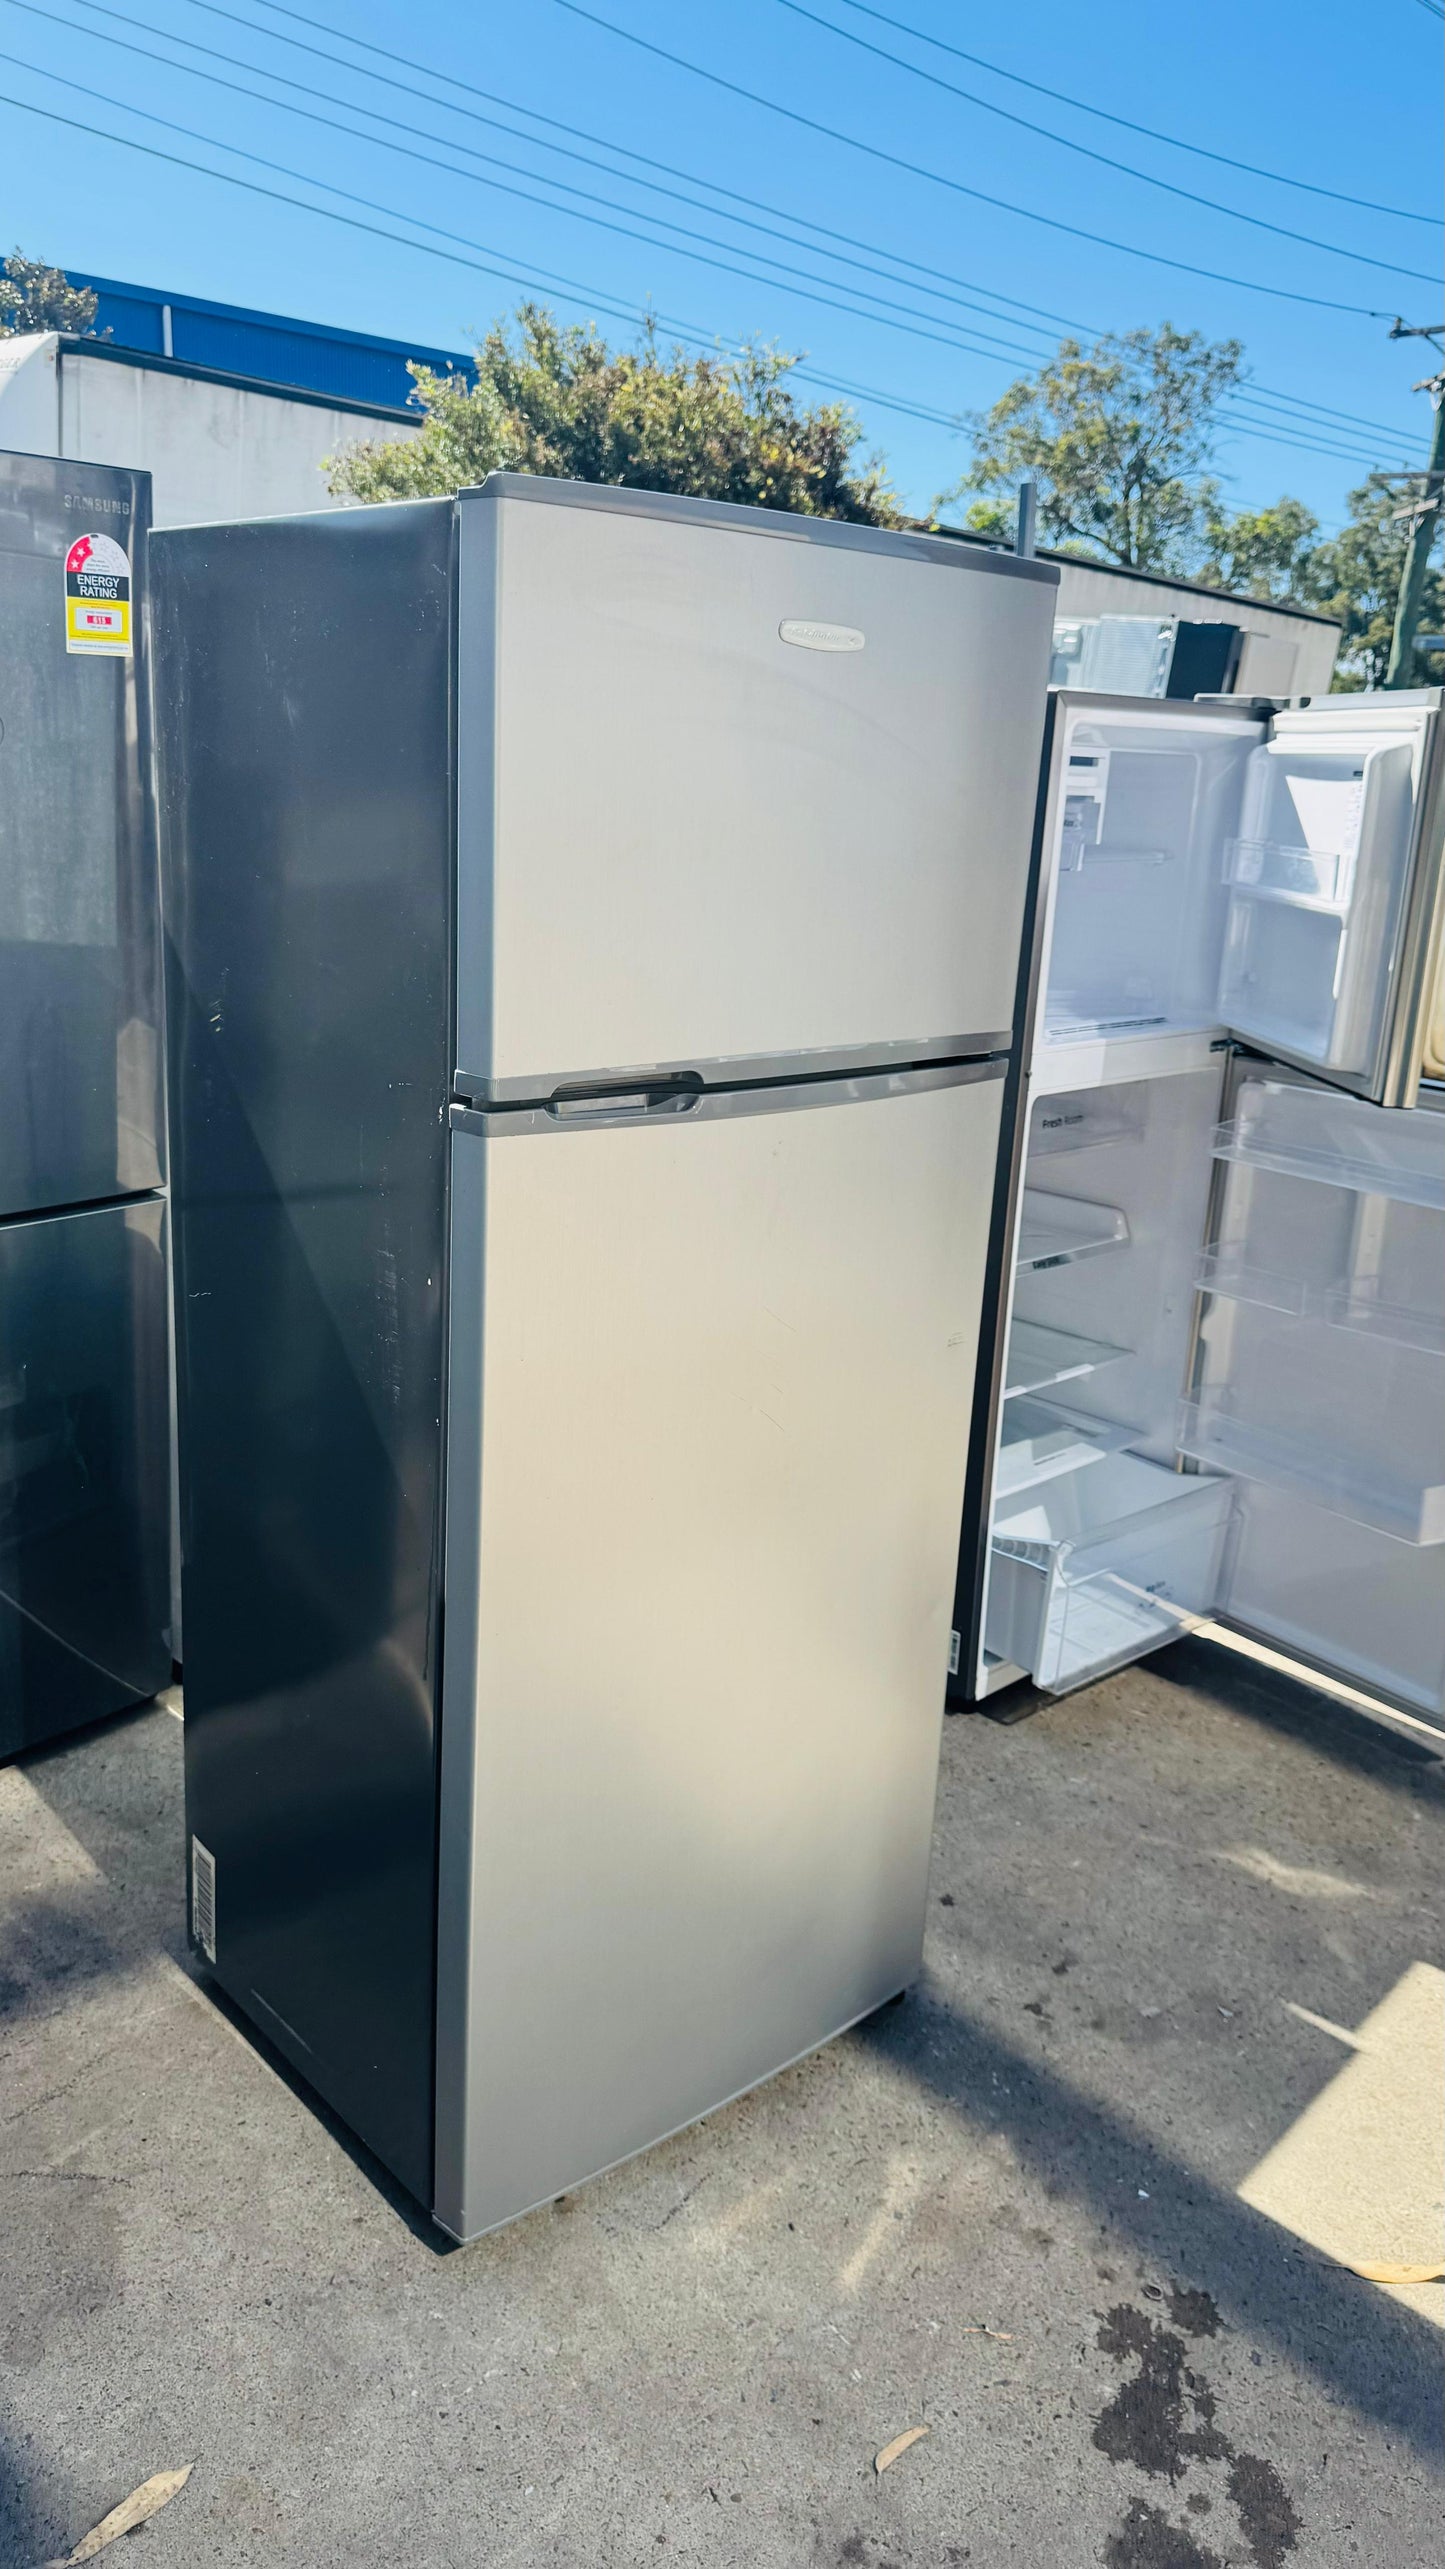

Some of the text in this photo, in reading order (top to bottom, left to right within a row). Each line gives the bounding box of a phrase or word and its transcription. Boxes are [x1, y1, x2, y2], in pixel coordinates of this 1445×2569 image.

[64, 494, 130, 515] SAMSUNG
[77, 575, 120, 589] ENERGY
[80, 586, 118, 599] RATING
